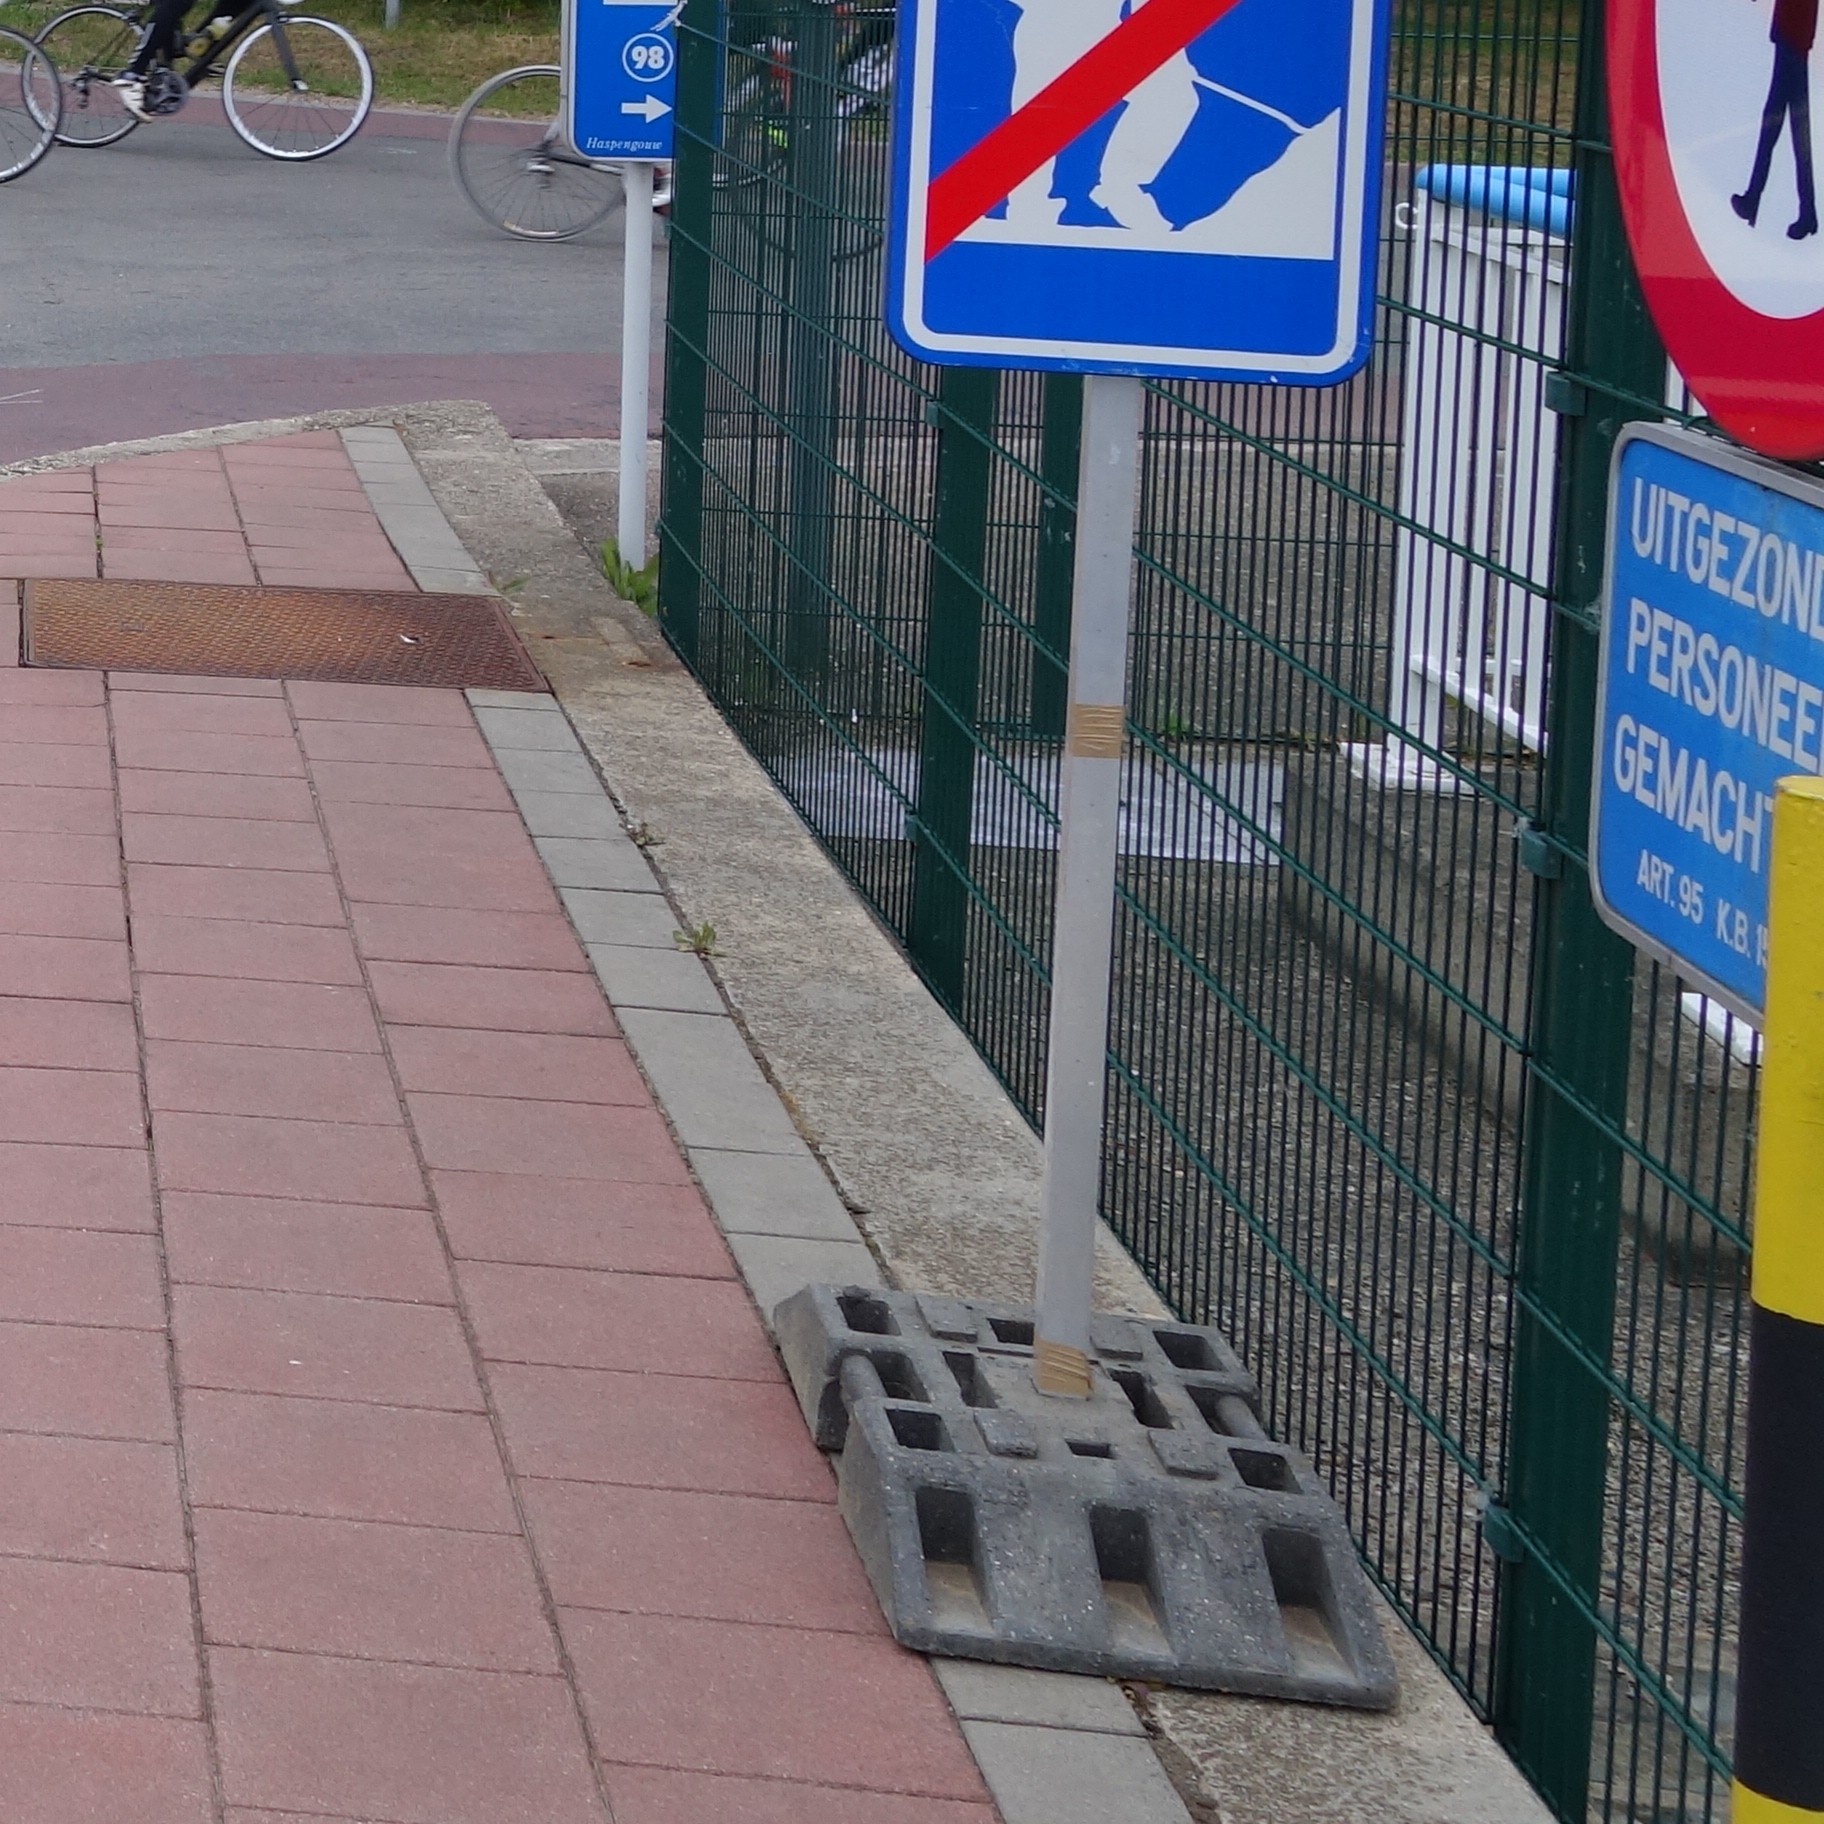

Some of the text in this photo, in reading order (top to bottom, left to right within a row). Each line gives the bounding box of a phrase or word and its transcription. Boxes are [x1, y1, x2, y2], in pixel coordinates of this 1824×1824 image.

[631, 45, 665, 70] 98
[586, 137, 663, 152] Haspengouw
[1627, 597, 1824, 775] PERSONEE
[1716, 899, 1751, 959] K.B.
